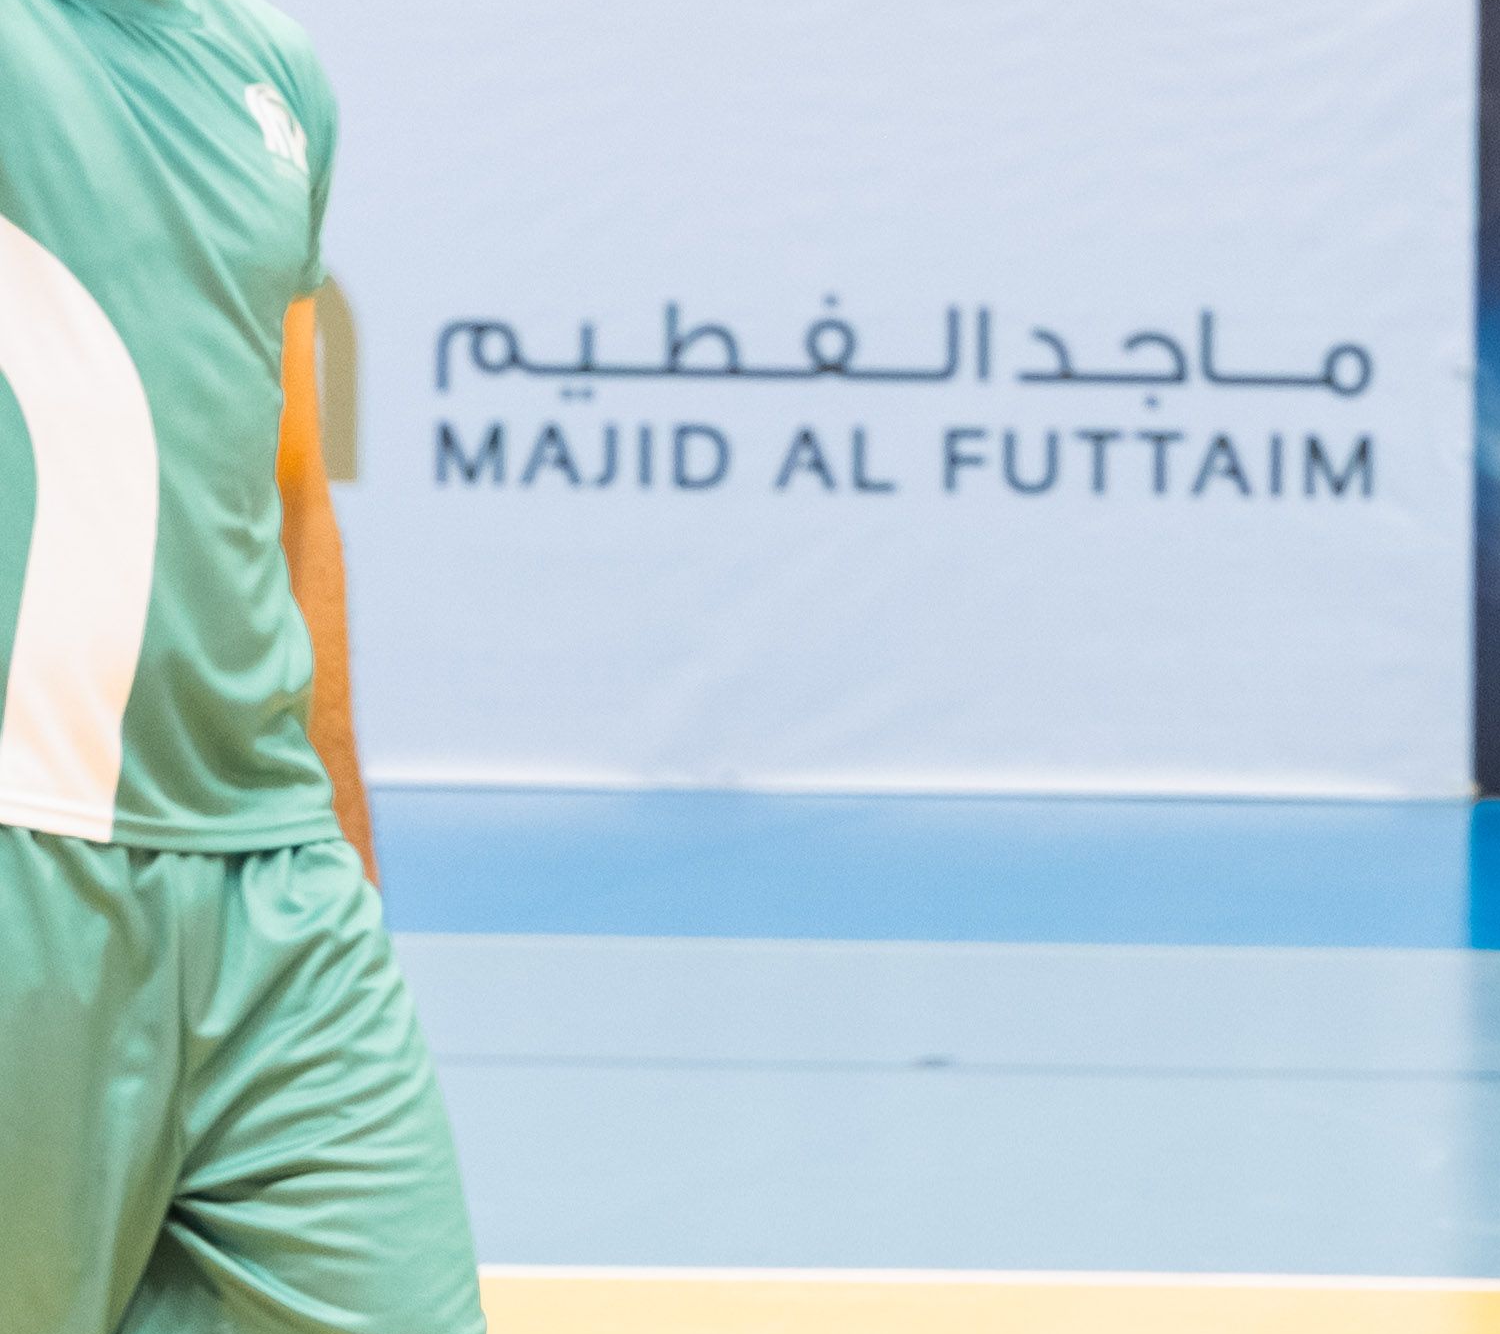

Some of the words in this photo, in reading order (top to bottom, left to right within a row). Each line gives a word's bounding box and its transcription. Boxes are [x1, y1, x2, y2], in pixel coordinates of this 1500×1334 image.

[435, 295, 991, 399] الفطيم
[1017, 309, 1374, 407] ماجد
[434, 421, 731, 491] MAJID
[774, 427, 896, 494] AL
[942, 427, 1375, 498] FUTTAIM
